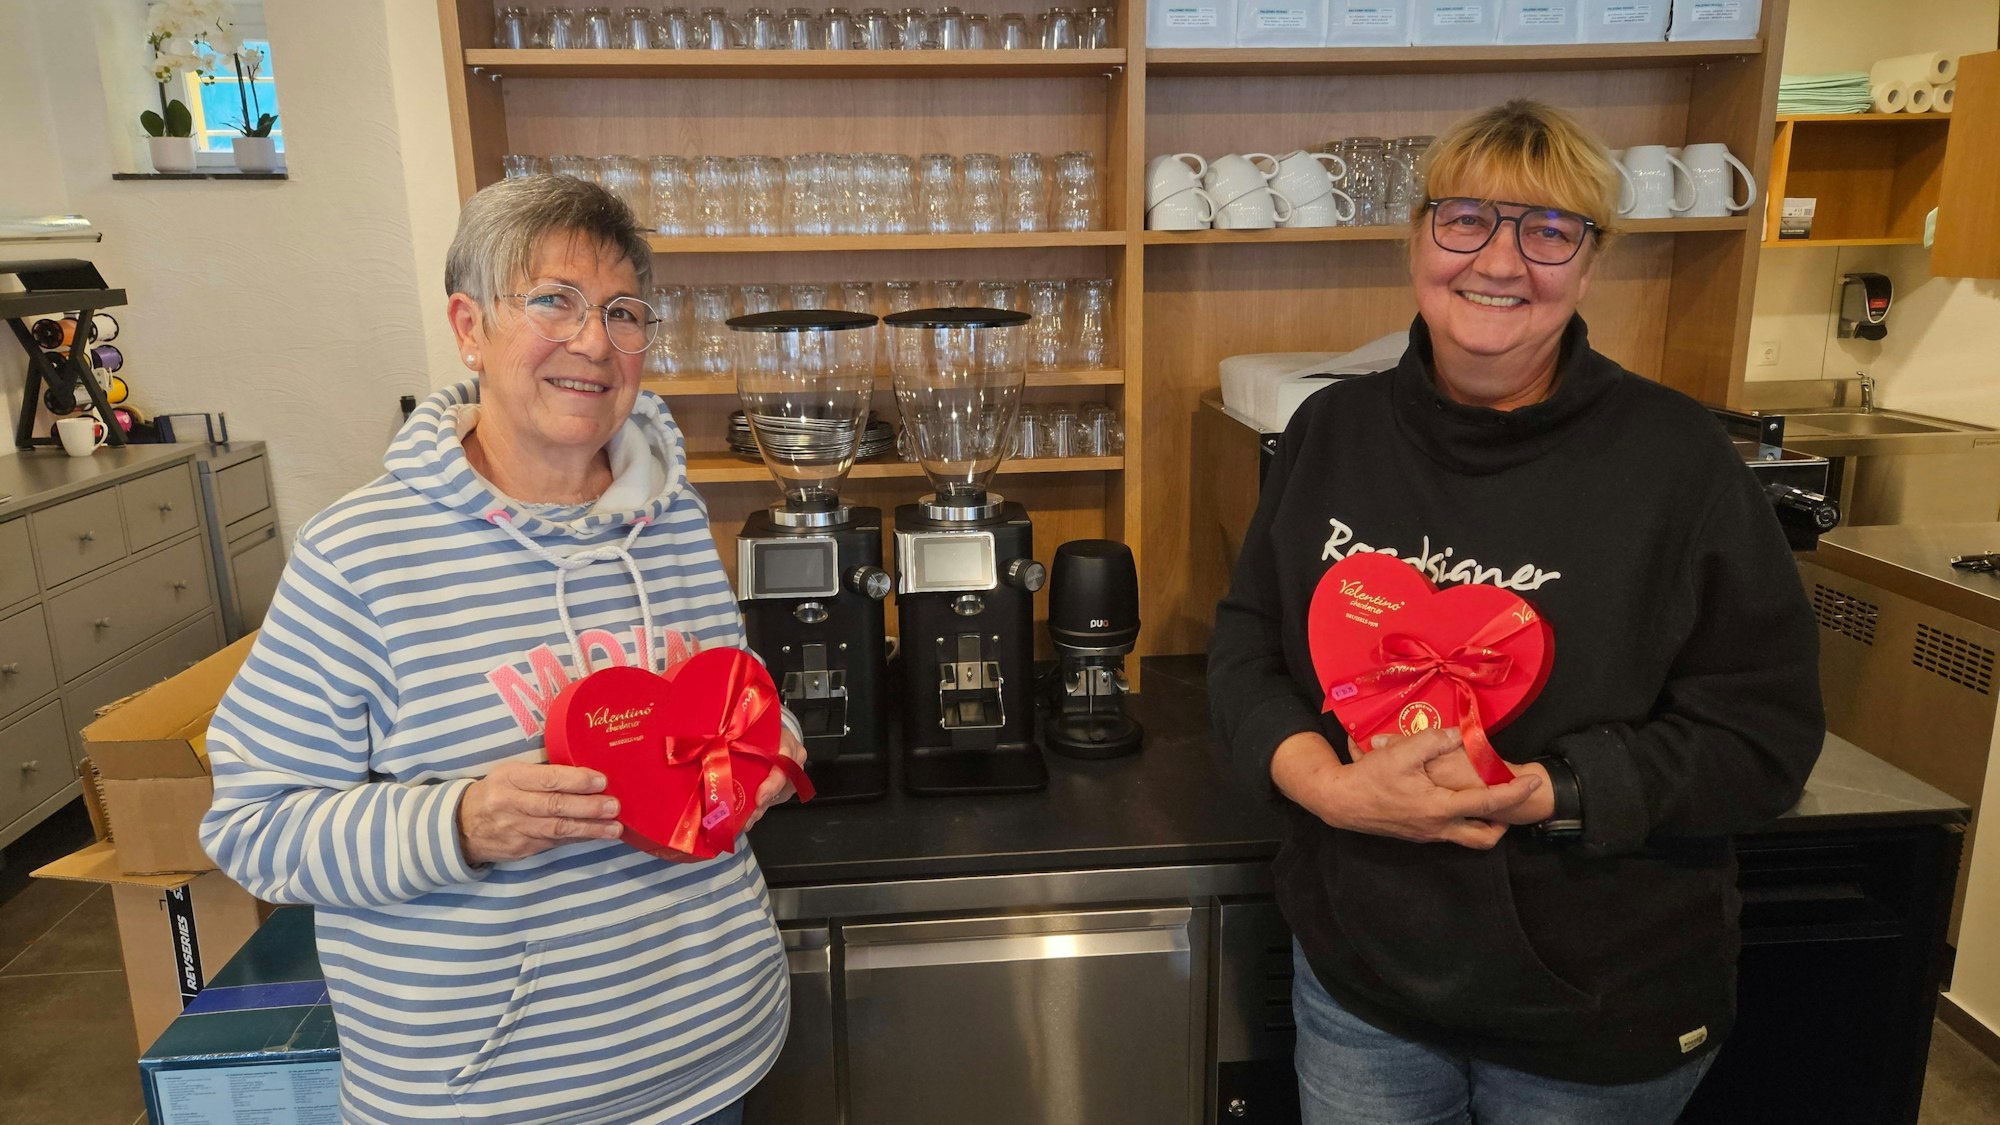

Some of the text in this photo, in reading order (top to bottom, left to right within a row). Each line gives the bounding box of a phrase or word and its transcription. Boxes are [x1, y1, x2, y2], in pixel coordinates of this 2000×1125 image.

[1322, 517, 1561, 591] Rdsigner
[1339, 579, 1402, 611] Valentino
[584, 704, 653, 728] Valentino
[176, 913, 198, 991] REVSERIES
